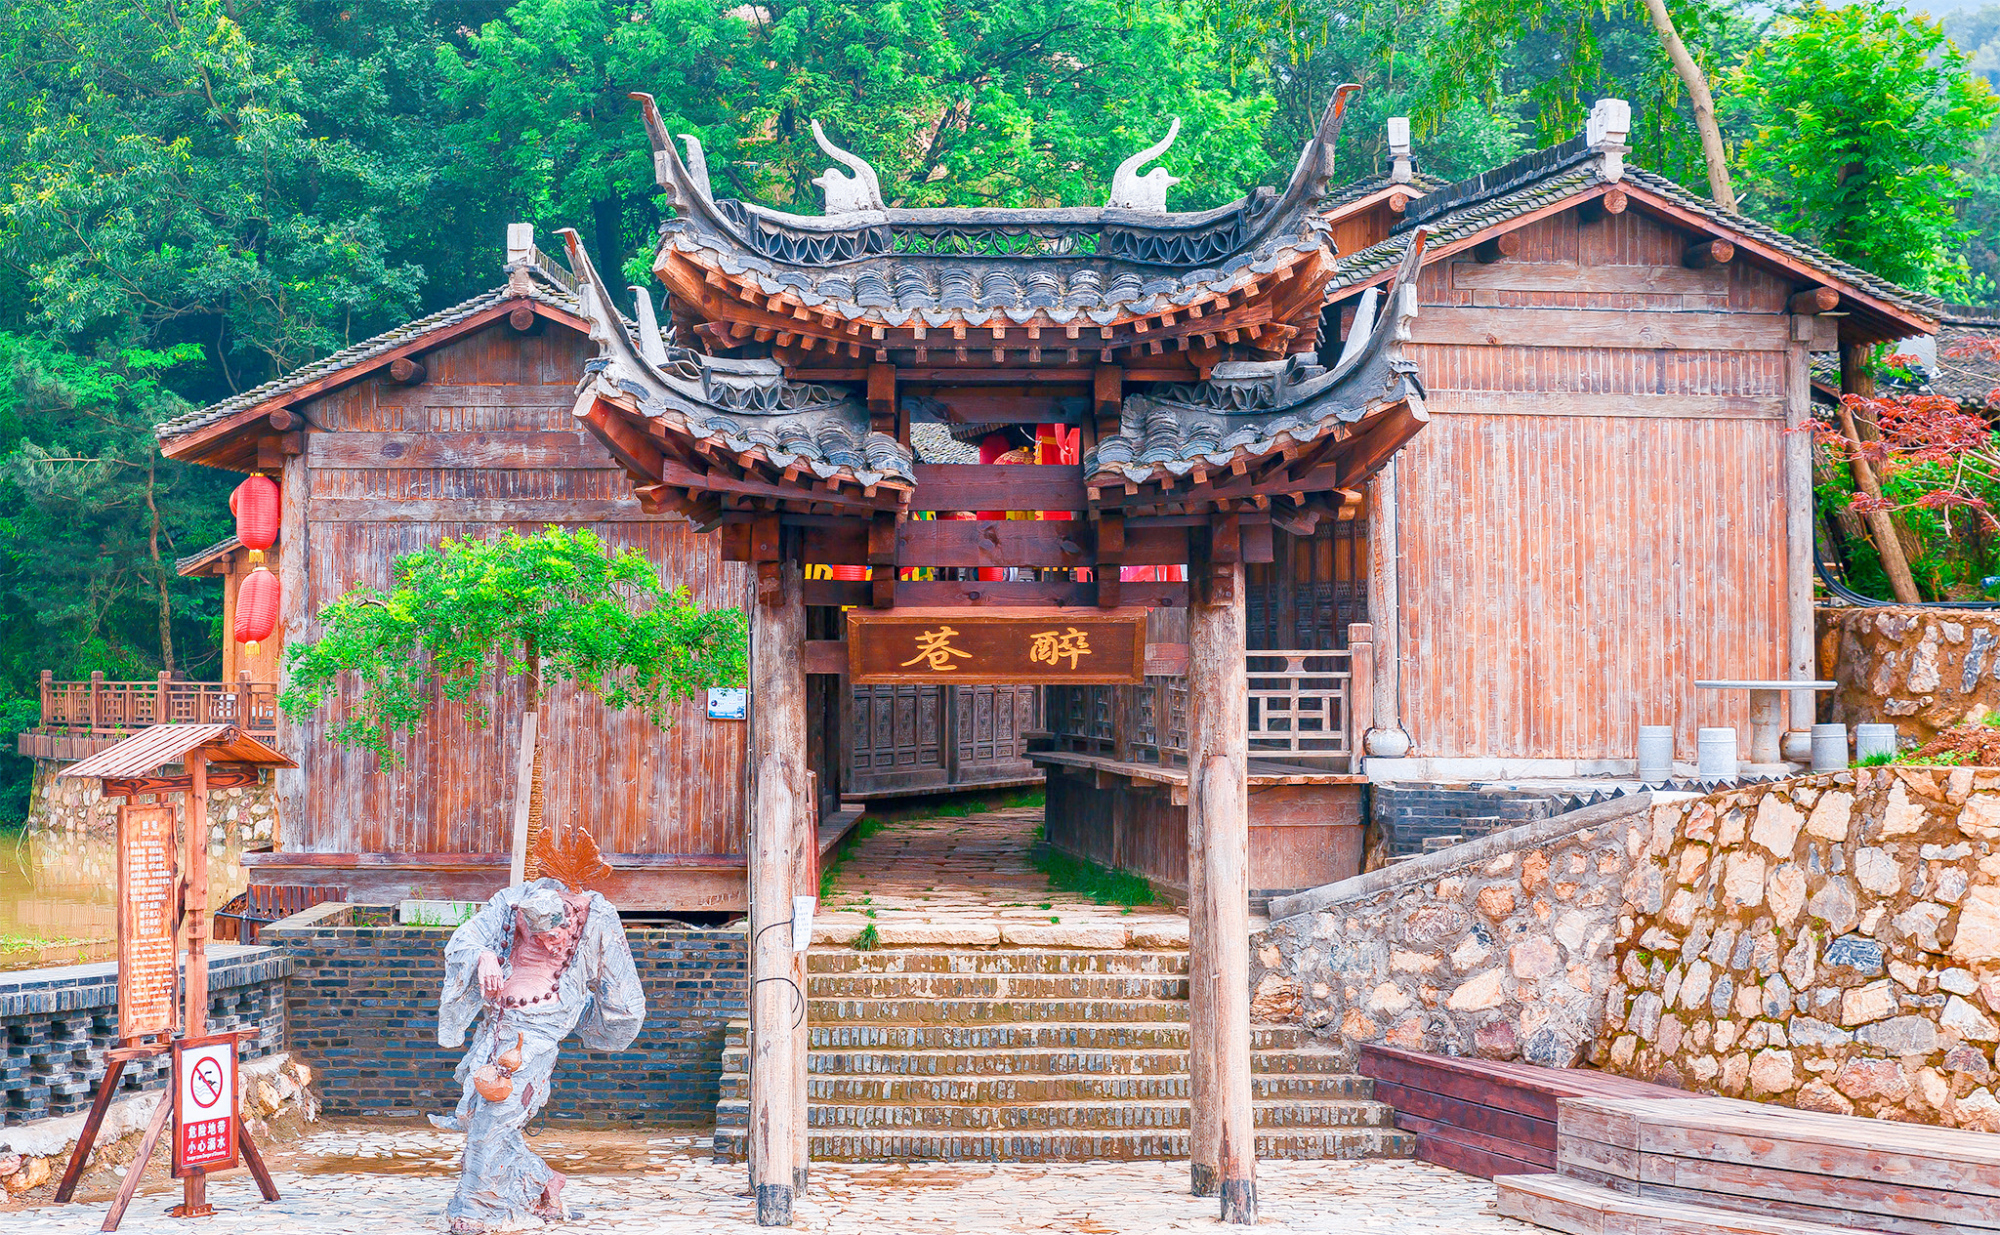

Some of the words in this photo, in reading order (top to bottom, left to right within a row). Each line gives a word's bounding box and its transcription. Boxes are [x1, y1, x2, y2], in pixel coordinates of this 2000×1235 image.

[188, 1120, 226, 1139] 危险地带
[187, 1135, 226, 1154] 小心溺水
